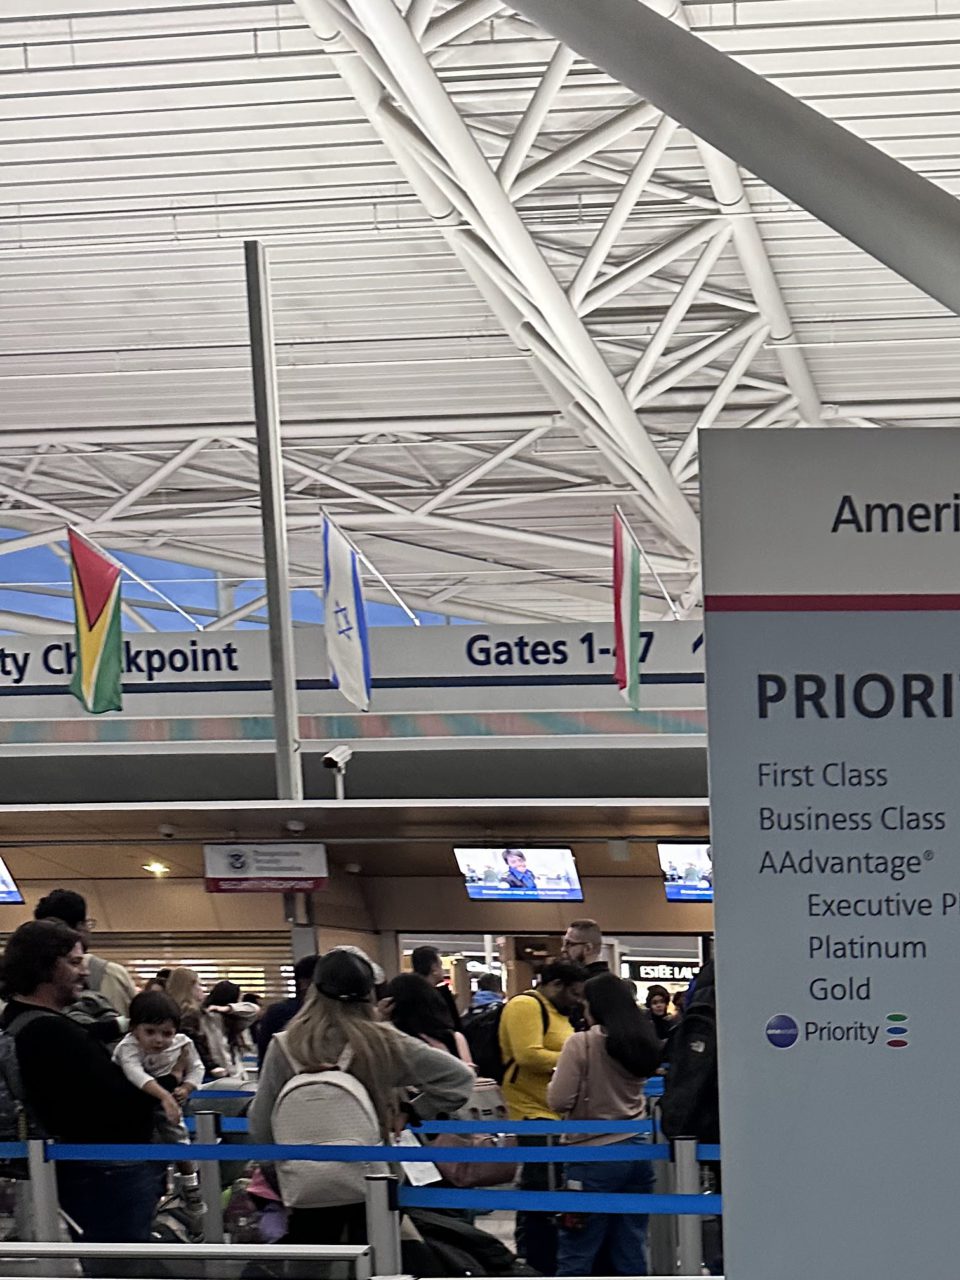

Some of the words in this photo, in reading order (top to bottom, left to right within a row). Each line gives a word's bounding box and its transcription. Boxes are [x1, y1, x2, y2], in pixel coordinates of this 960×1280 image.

[42, 640, 239, 681] Chkpoint
[466, 634, 568, 666] Gates
[579, 631, 654, 664] 1-7
[758, 762, 815, 787] First
[822, 761, 888, 787] Class
[759, 807, 872, 831] Business
[881, 806, 946, 830] Class
[808, 893, 933, 917] Executive
[809, 935, 927, 959] Platinum
[809, 977, 871, 1000] Gold
[805, 1021, 879, 1044] Priority
